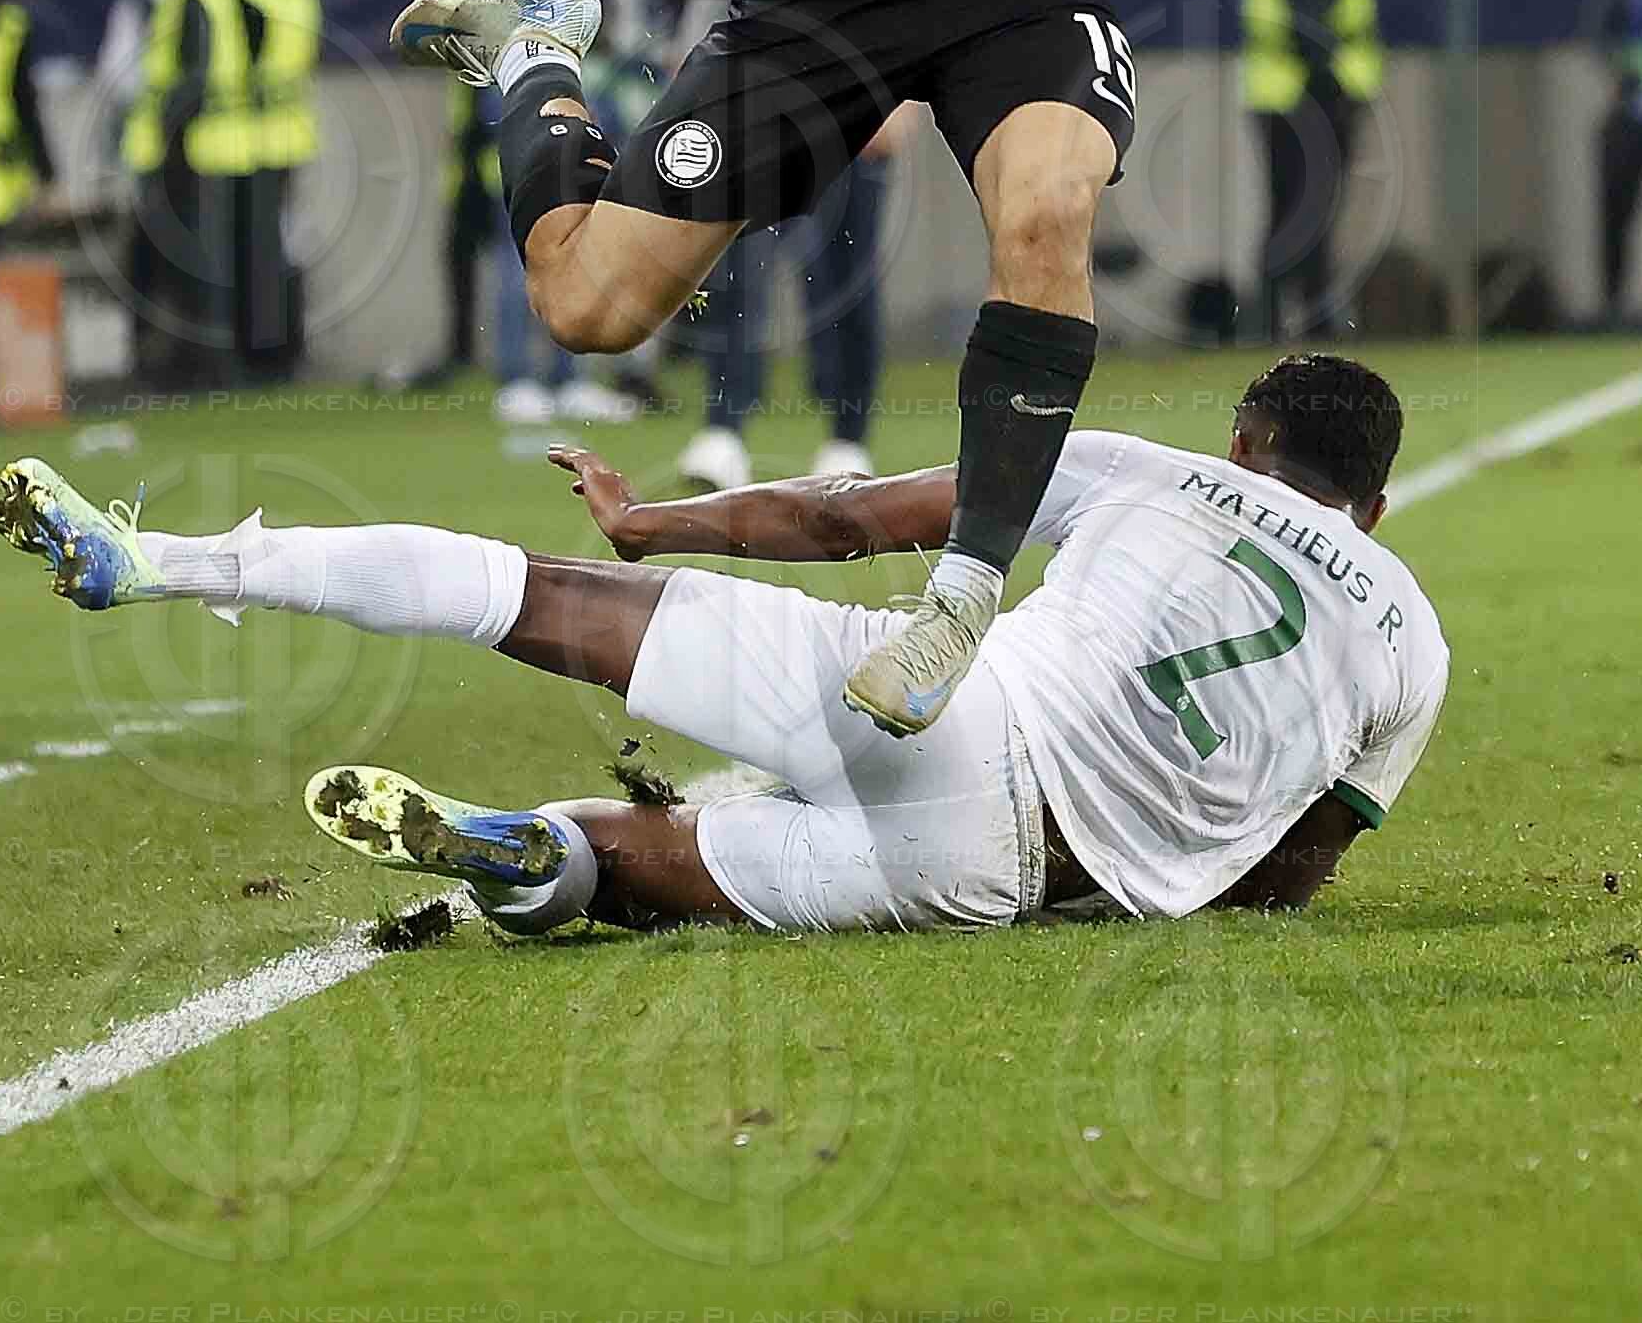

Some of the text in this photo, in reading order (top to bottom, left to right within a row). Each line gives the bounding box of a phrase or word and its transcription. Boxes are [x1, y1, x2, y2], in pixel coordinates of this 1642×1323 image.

[1135, 537, 1307, 761] 2
[1179, 469, 1404, 653] MATHEUS R.
